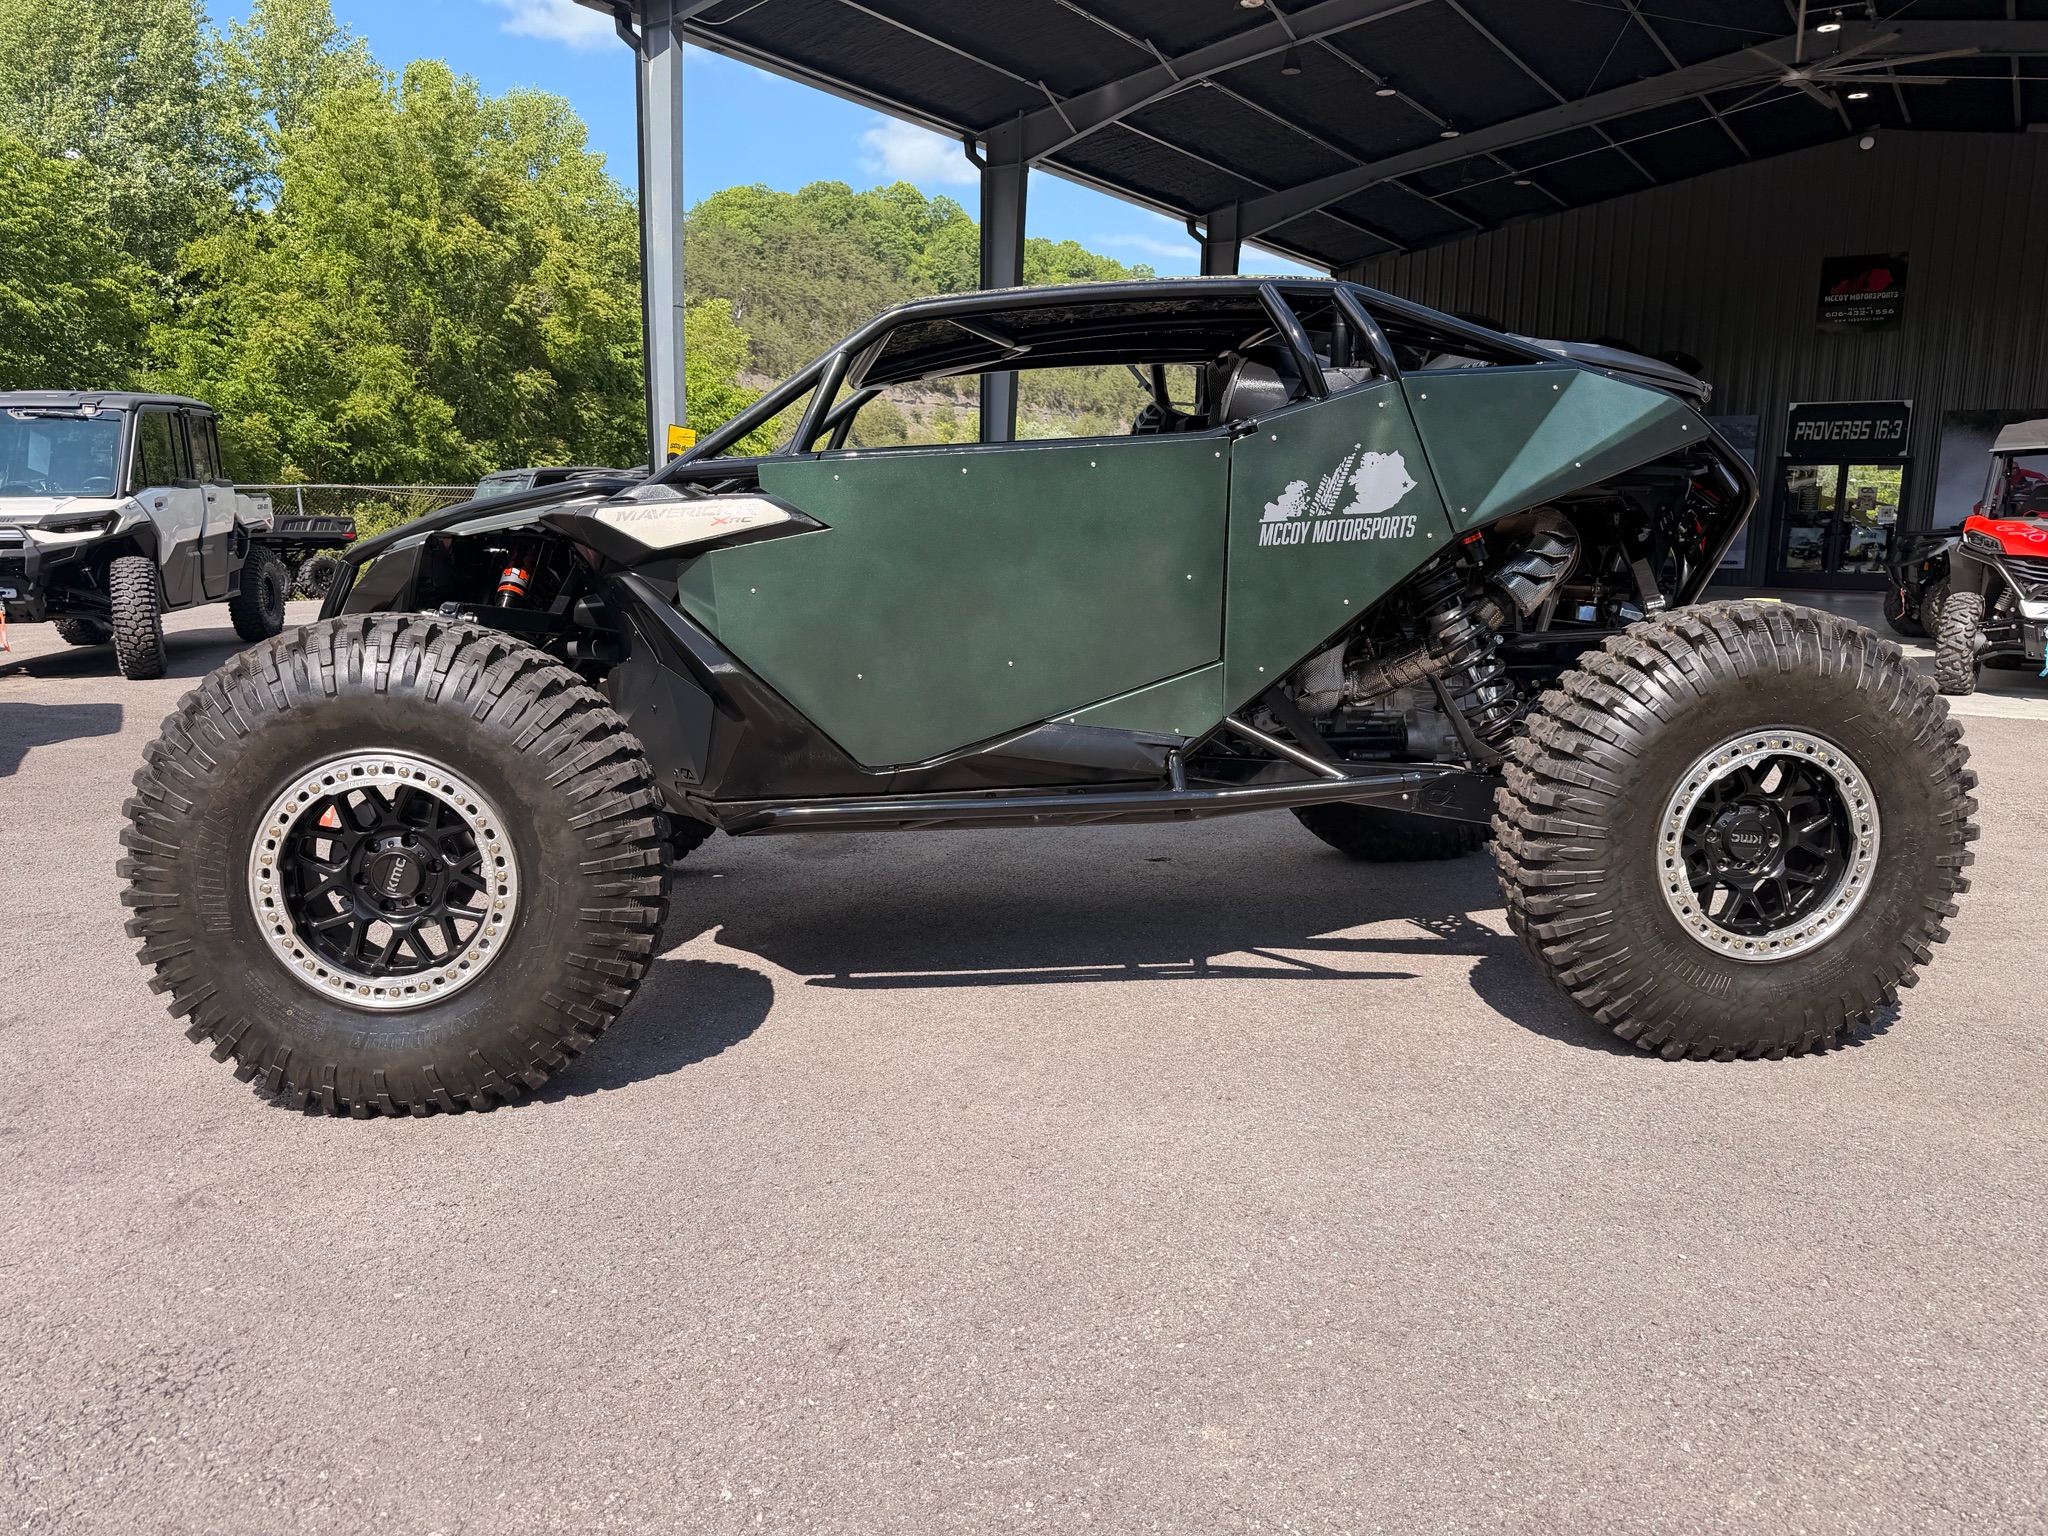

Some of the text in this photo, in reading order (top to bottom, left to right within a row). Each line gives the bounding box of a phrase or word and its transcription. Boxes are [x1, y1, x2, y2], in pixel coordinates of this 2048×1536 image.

[1824, 291, 1899, 302] MCCOY MOTORSPORTS
[1825, 308, 1895, 318] 606-432-1556
[1794, 419, 1903, 441] PROVERBS 16:3
[1258, 515, 1417, 547] MCCOY MOTORSPORTS
